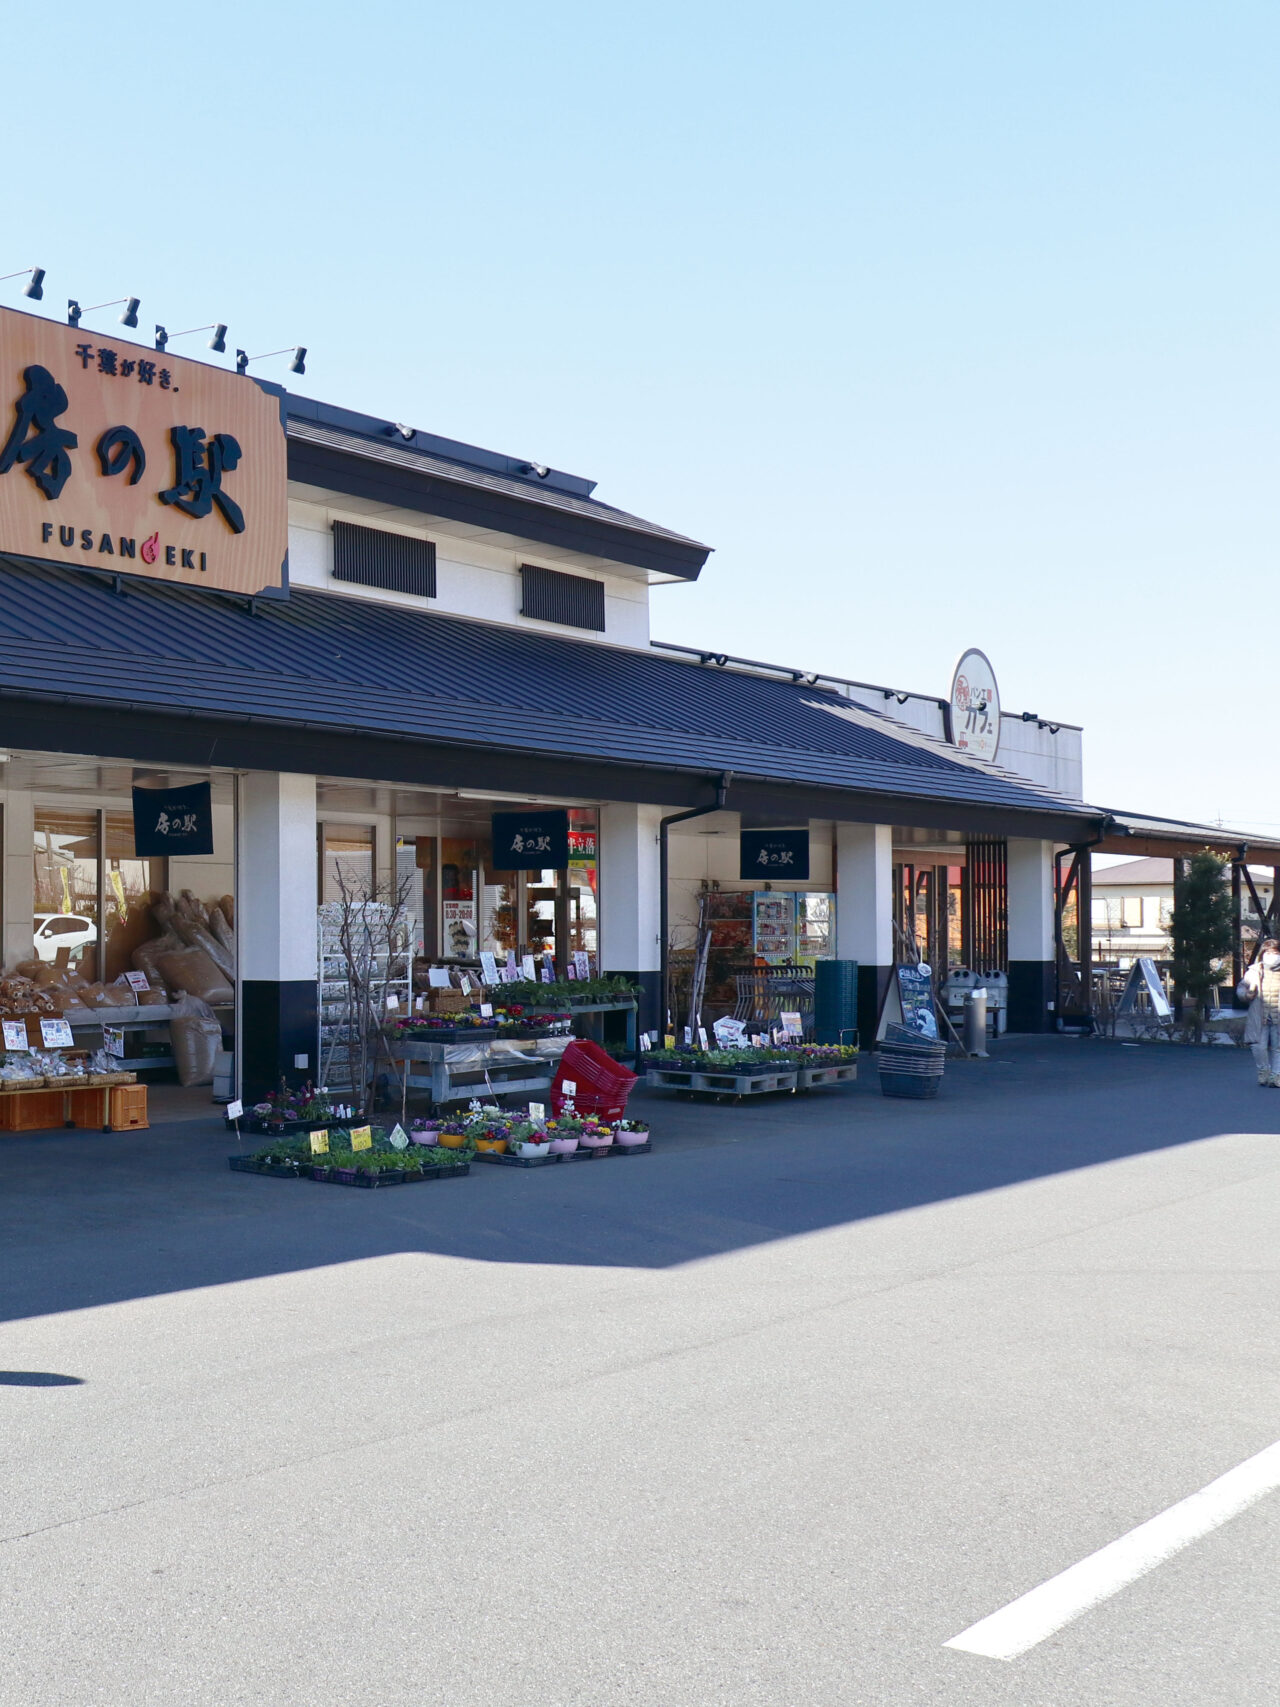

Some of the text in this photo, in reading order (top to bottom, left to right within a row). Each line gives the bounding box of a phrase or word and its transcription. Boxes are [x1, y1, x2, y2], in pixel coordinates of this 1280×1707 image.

[154, 811, 198, 836] 房の駅
[510, 833, 552, 854] 房の駅
[756, 848, 795, 866] 房の駅
